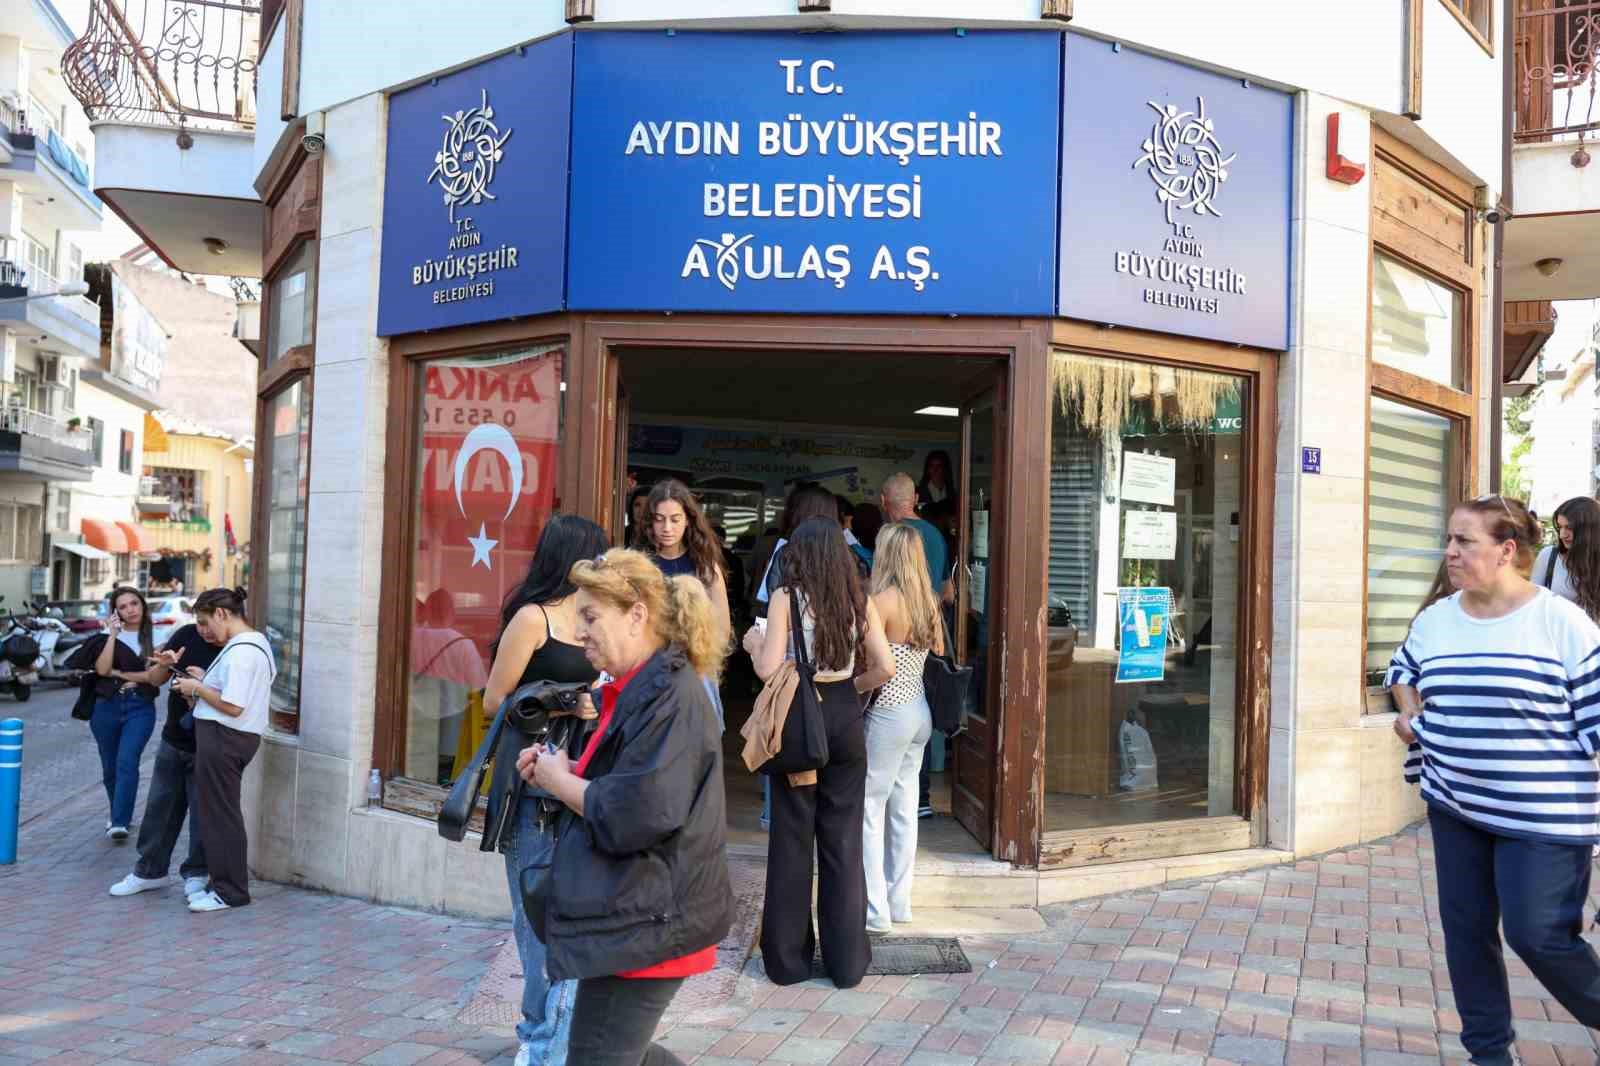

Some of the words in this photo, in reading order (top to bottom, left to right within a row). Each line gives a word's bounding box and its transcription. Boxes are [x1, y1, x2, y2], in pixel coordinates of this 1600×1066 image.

[779, 59, 844, 95] T.C.
[625, 120, 740, 156] AYDIN
[758, 111, 1003, 166] BÜYÜKŞEHİR
[703, 174, 921, 219] BELEDİYESİ
[455, 217, 474, 233] T.C.
[1173, 222, 1195, 239] T.C.
[448, 232, 481, 250] AYDIN
[1164, 237, 1205, 258] AYDIN
[412, 243, 519, 286] BÜYÜKŞEHİR
[869, 244, 940, 291] A.Ş.
[1115, 249, 1248, 295] BÜYÜKŞEHİR
[433, 278, 494, 305] BELEDİYESİ
[1144, 287, 1221, 314] BELEDİYESİ
[1216, 416, 1242, 429] WC
[1308, 451, 1318, 464] 15
